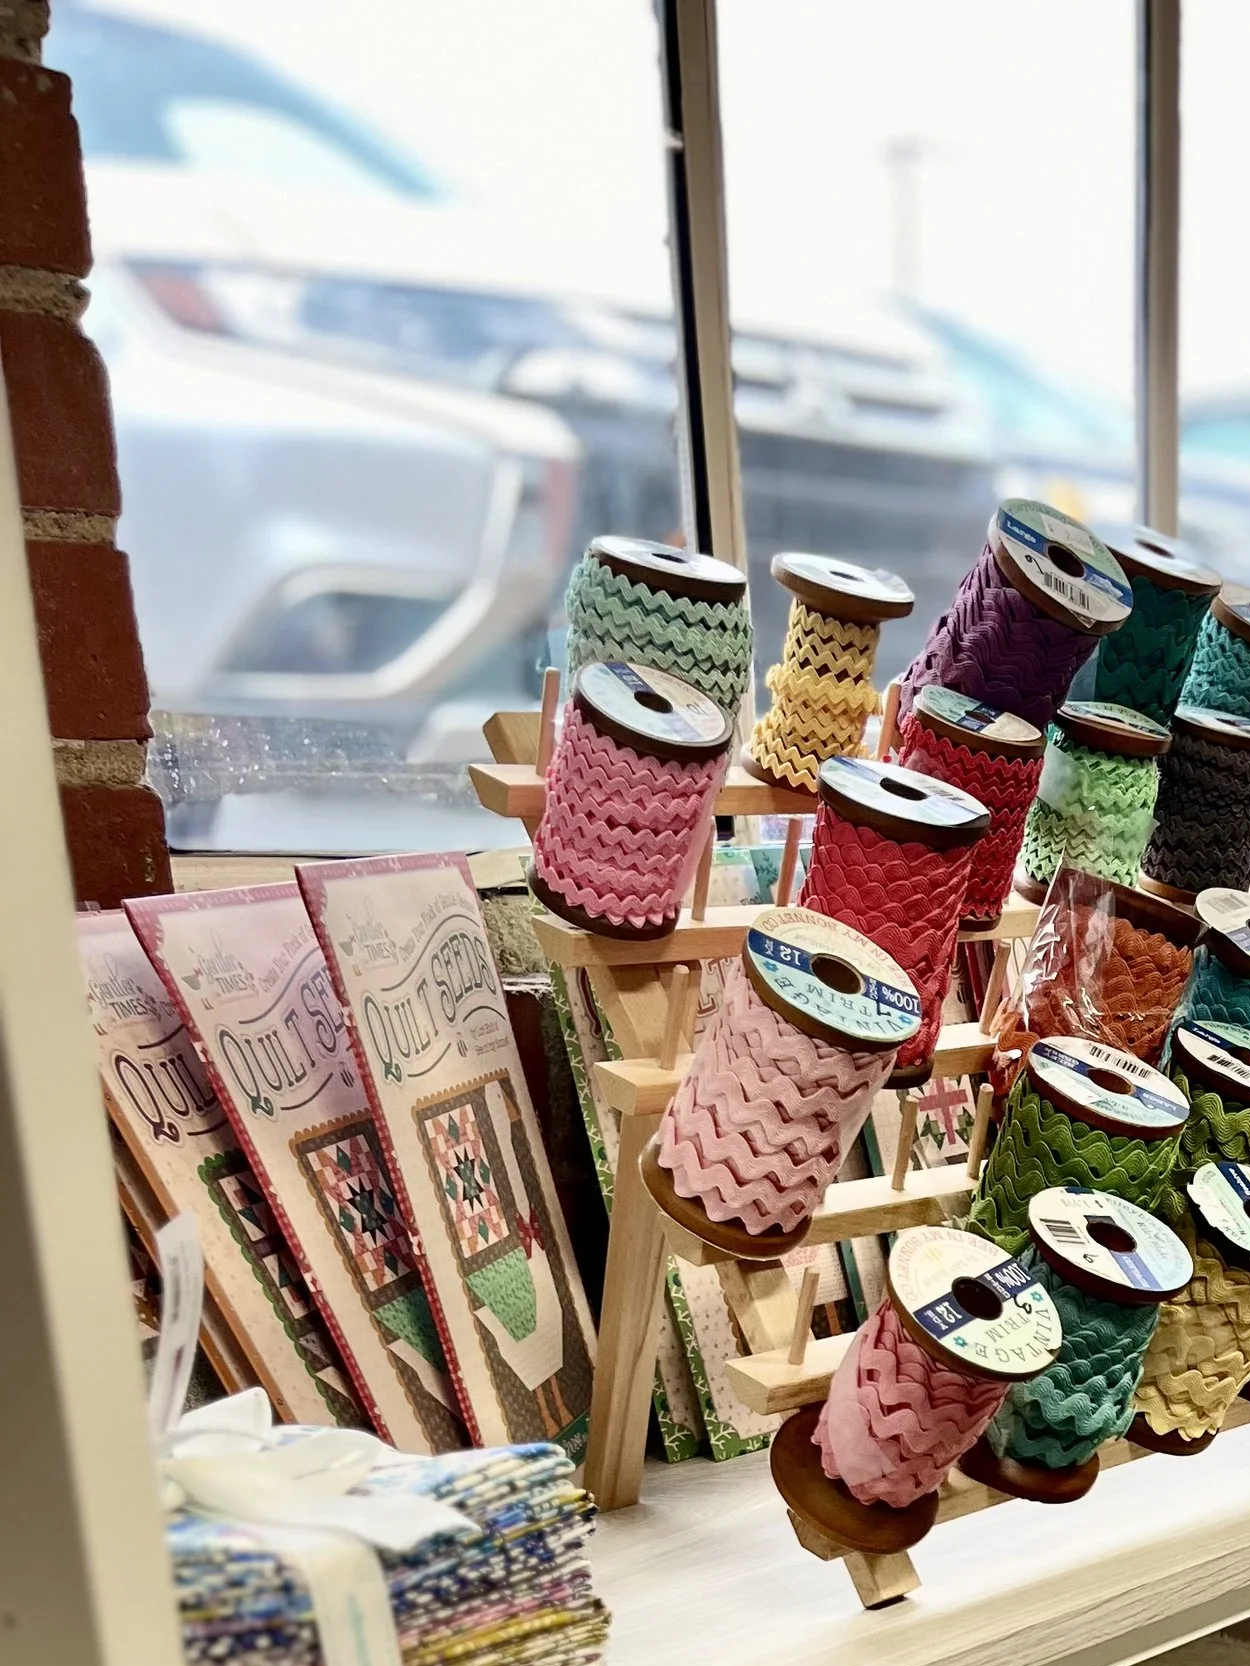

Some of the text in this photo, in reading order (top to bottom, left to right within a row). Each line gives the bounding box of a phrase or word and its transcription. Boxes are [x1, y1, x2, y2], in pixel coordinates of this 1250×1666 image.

[1006, 519, 1037, 544] Large
[776, 911, 838, 936] BONNET
[779, 945, 803, 967] 12
[215, 973, 248, 995] TIMES
[109, 997, 149, 1021] TIMES
[364, 976, 439, 1083] QUILT
[431, 932, 498, 1023] SEEDS
[773, 976, 906, 1035] VINTAGE
[805, 982, 874, 1018] TRIM
[881, 986, 921, 1014] 100%
[218, 1007, 317, 1117] QUILT
[113, 1052, 219, 1143] QUIL
[994, 1262, 1032, 1289] 100%
[935, 1300, 963, 1325] 12
[974, 1307, 1053, 1363] VINTAGE
[984, 1311, 1031, 1343] TRIM
